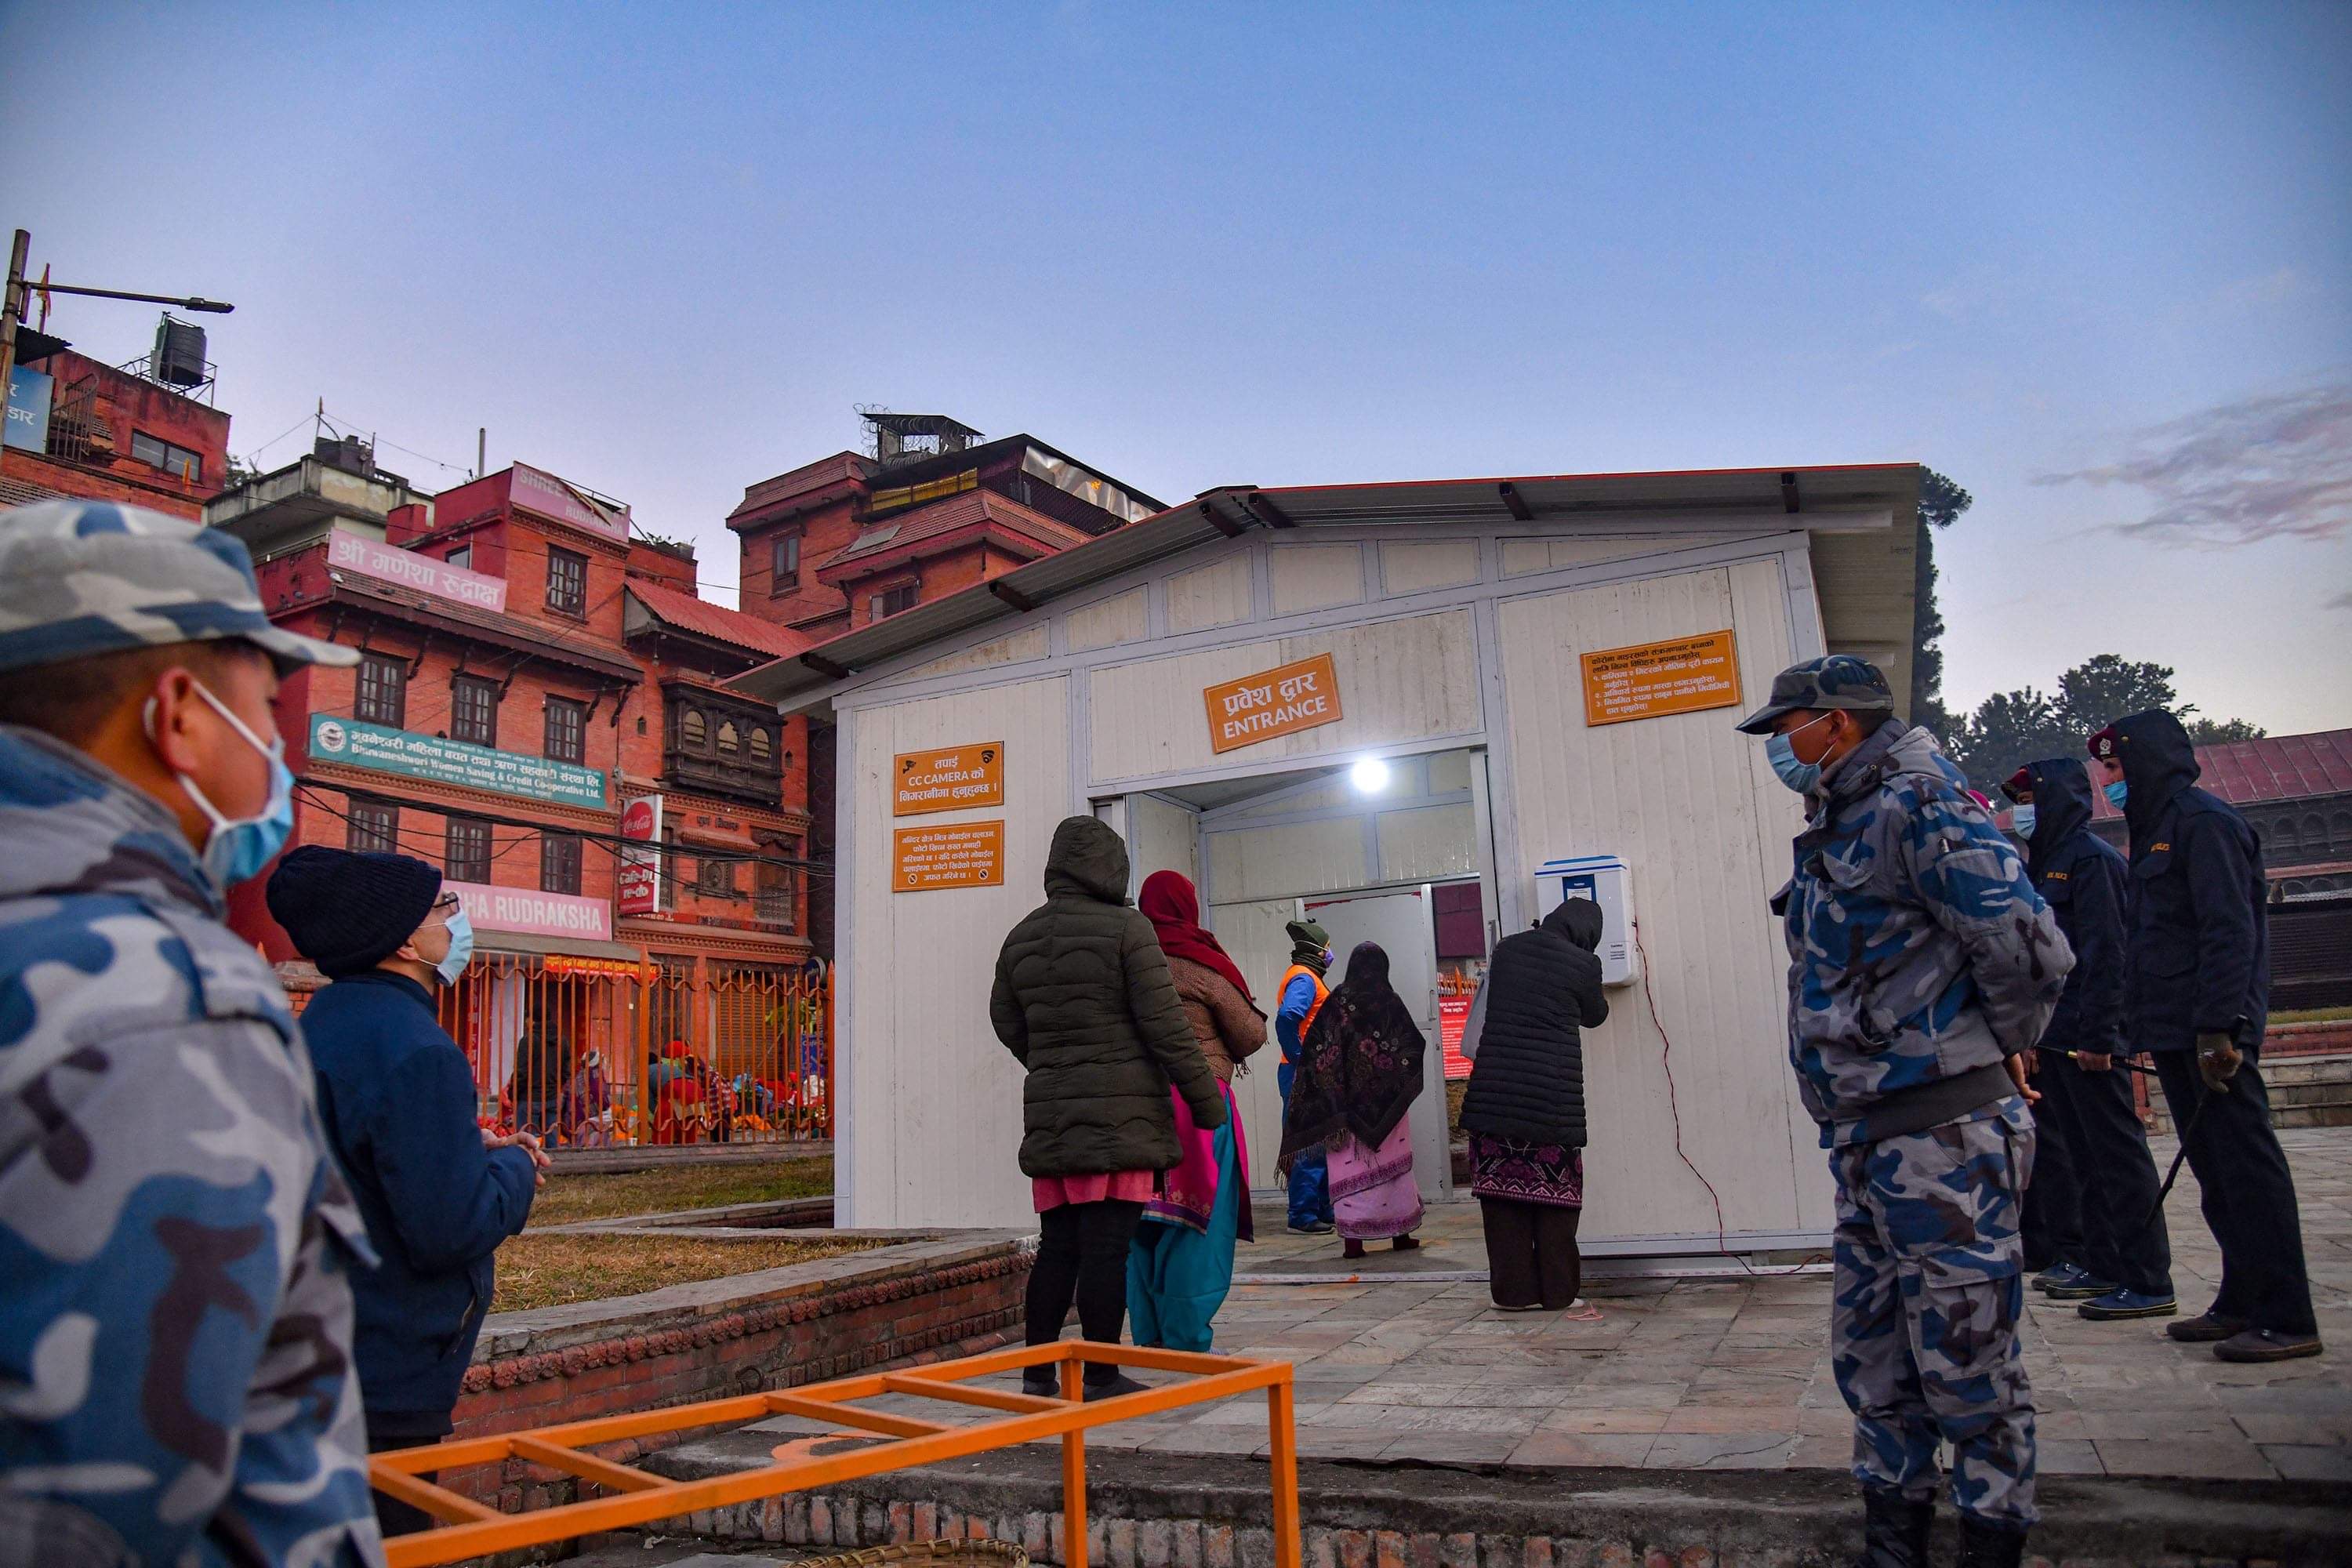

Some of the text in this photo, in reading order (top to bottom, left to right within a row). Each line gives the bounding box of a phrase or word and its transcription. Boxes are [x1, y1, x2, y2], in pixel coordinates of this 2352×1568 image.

[338, 539, 365, 564] श्री
[372, 552, 436, 586] गणेशा
[1223, 672, 1317, 717] प्रवेश द्वार
[1224, 695, 1327, 739] ENTRANCE
[406, 741, 441, 757] महिला
[471, 755, 491, 767] तथा
[560, 771, 584, 785] संस्था
[430, 758, 464, 774] Women
[466, 765, 495, 781] Saving
[506, 772, 532, 786] Credit
[908, 767, 985, 786] CC CAMERA को
[899, 787, 949, 803] निगरानीमा
[953, 783, 989, 799] हुनुहुन्छ
[495, 896, 603, 931] RUDRAKSHA
